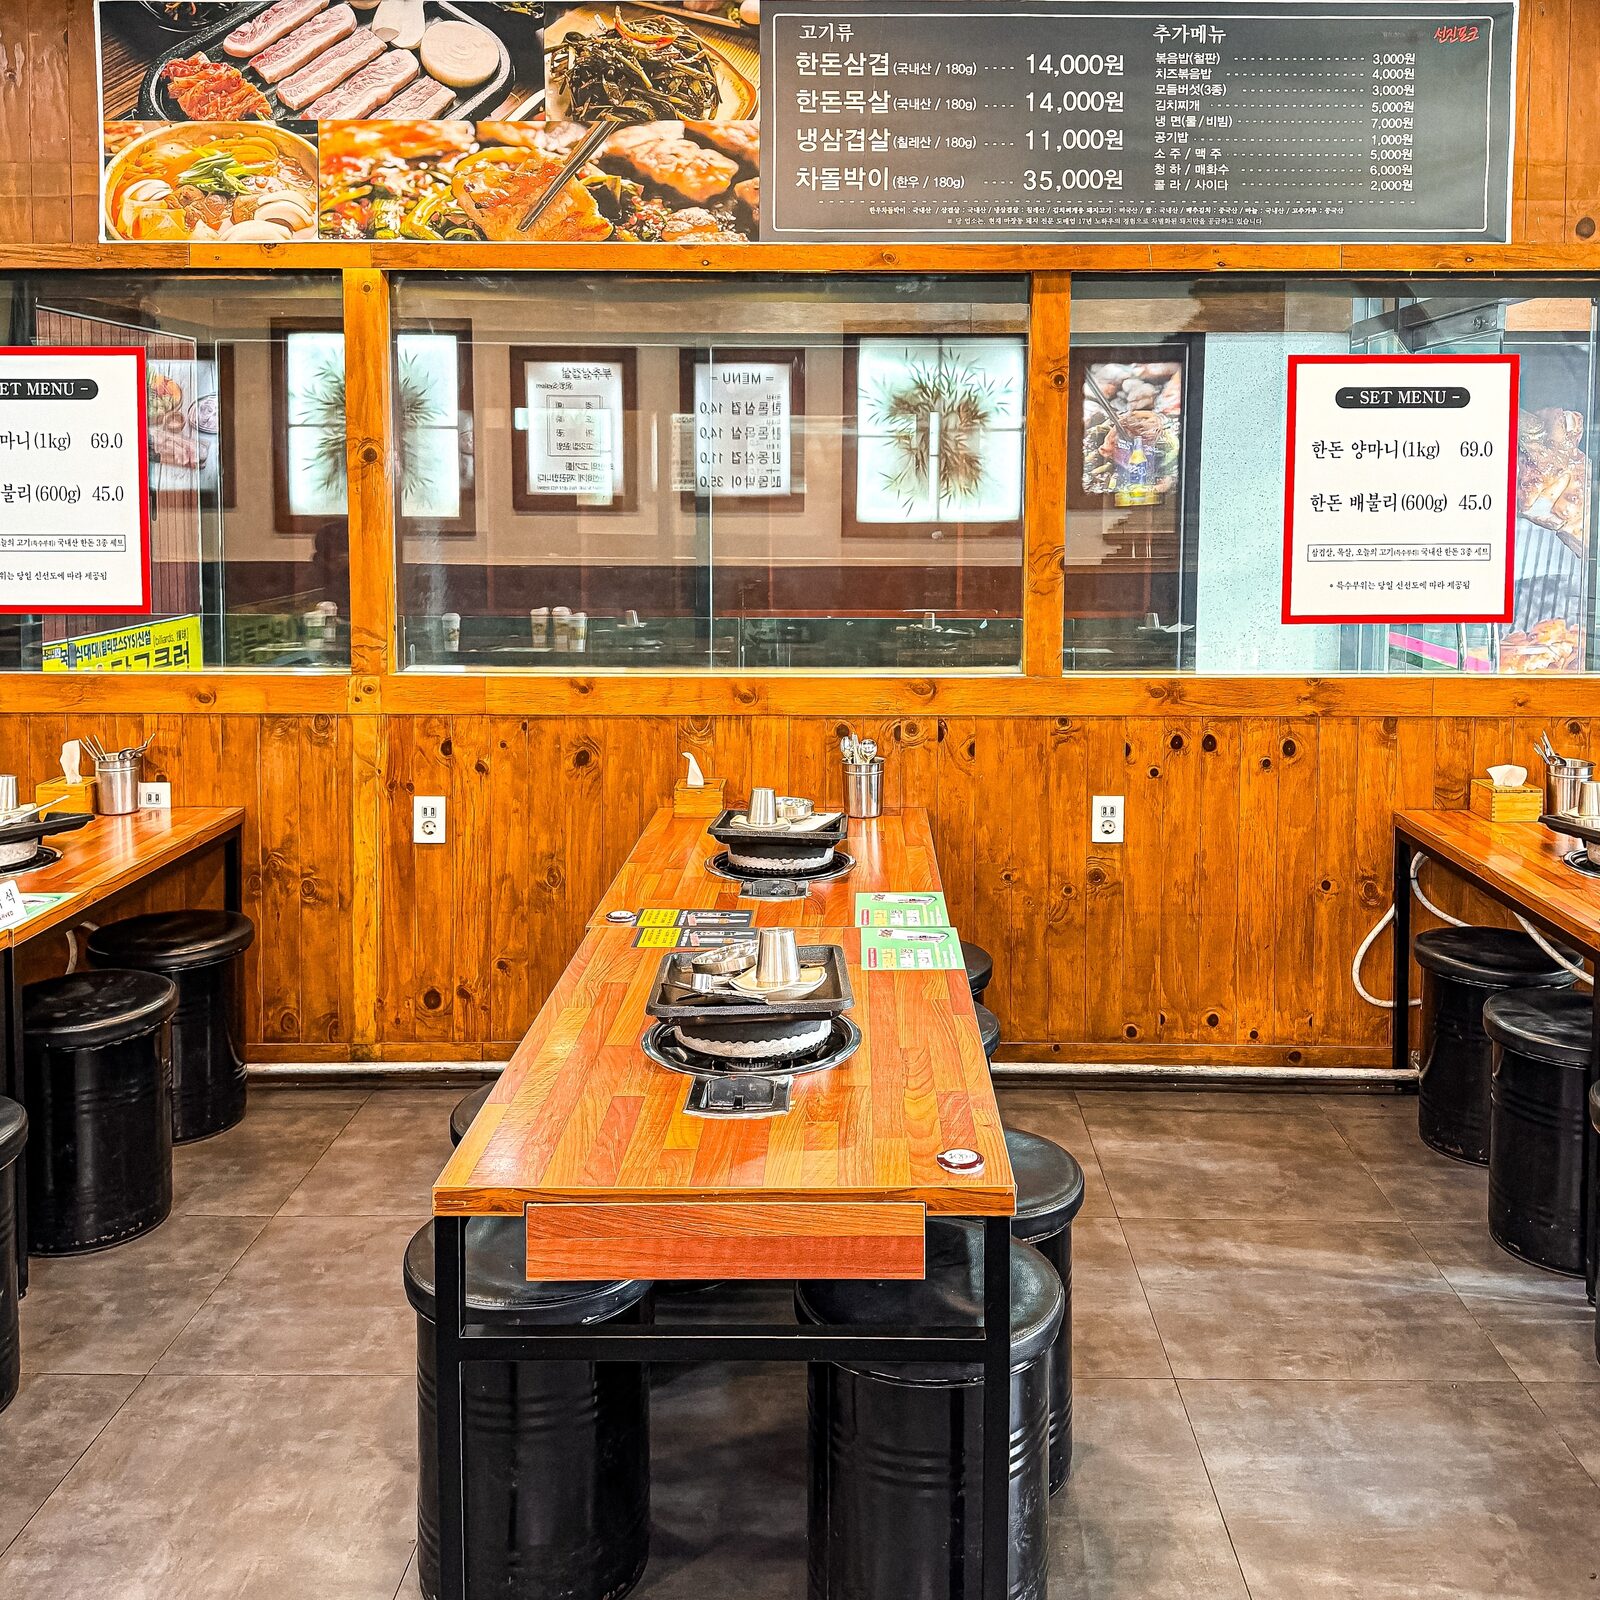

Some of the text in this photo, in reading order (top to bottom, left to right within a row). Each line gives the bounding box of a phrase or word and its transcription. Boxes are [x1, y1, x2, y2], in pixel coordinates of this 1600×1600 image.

[799, 23, 854, 42] 고기류
[1153, 24, 1226, 44] 추가메뉴
[796, 52, 888, 75] 한돈삼겹
[1027, 54, 1123, 77] 14,000원
[1156, 52, 1415, 65] 볶음밥(철판) 3,000원
[1156, 68, 1414, 80] 치즈볶음밥 4,000원
[1155, 84, 1414, 96] 모듬버섯(3종) 3,000원
[796, 90, 891, 113] 한돈목살
[1026, 91, 1123, 113] 14,000원
[1156, 100, 1414, 113] 김치찌개 5,000원
[1371, 118, 1413, 129] 7,000원
[798, 128, 890, 152] 냉삼겹살
[1026, 129, 1123, 152] 11,000원
[1155, 132, 1412, 146] 공기밥 1,000원
[1370, 149, 1412, 161] 5,000원
[1195, 164, 1229, 175] 매화수
[1370, 164, 1412, 176] 6,000원
[796, 167, 888, 190] 차돌박이
[1023, 169, 1122, 192] 35,000원
[1195, 180, 1228, 191] 사이다
[1371, 180, 1412, 191] 2,000원
[27, 383, 74, 395] MENU
[1360, 391, 1446, 404] SET MENU
[91, 433, 122, 448] 69.0
[1312, 440, 1344, 459] 한돈
[1461, 441, 1492, 457] 69.0
[92, 486, 123, 501] 45.0
[1311, 494, 1342, 512] 한돈
[1459, 495, 1491, 510] 45.0
[0, 538, 14, 548] 늘의
[58, 538, 78, 548] 국내산
[80, 538, 94, 548] 한돈
[96, 538, 108, 548] 3종
[1356, 548, 1377, 558] 오늘의
[1421, 547, 1443, 557] 국내산
[1445, 547, 1458, 557] 한돈
[1460, 547, 1472, 557] 3종
[17, 571, 32, 581] 당일
[34, 571, 65, 581] 신선도에
[1378, 580, 1394, 590] 당일
[1396, 580, 1427, 590] 신선도에
